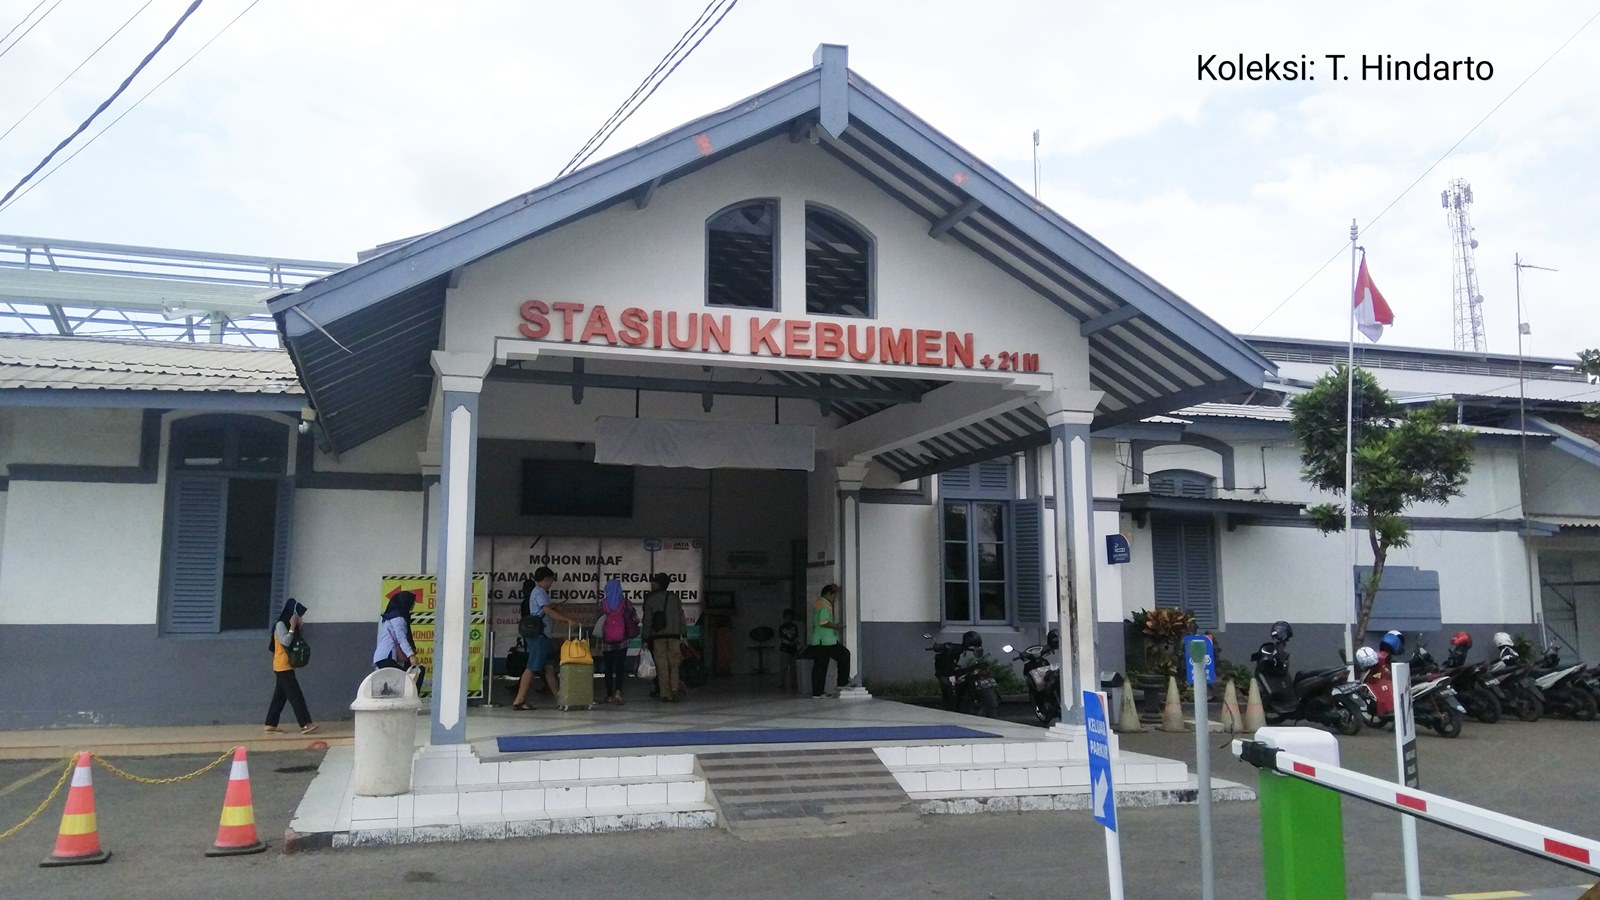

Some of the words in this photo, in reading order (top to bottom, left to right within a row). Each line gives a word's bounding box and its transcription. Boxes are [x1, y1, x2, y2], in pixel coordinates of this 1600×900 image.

[518, 299, 732, 353] STASIUN
[749, 316, 974, 369] KEBUMEN
[529, 554, 581, 566] MOHON
[585, 555, 623, 566] MAAF
[562, 572, 600, 583] ANDA
[603, 573, 687, 583] TERGANGU
[1087, 717, 1106, 736] KELUAR
[1089, 739, 1109, 760] PARKIR
